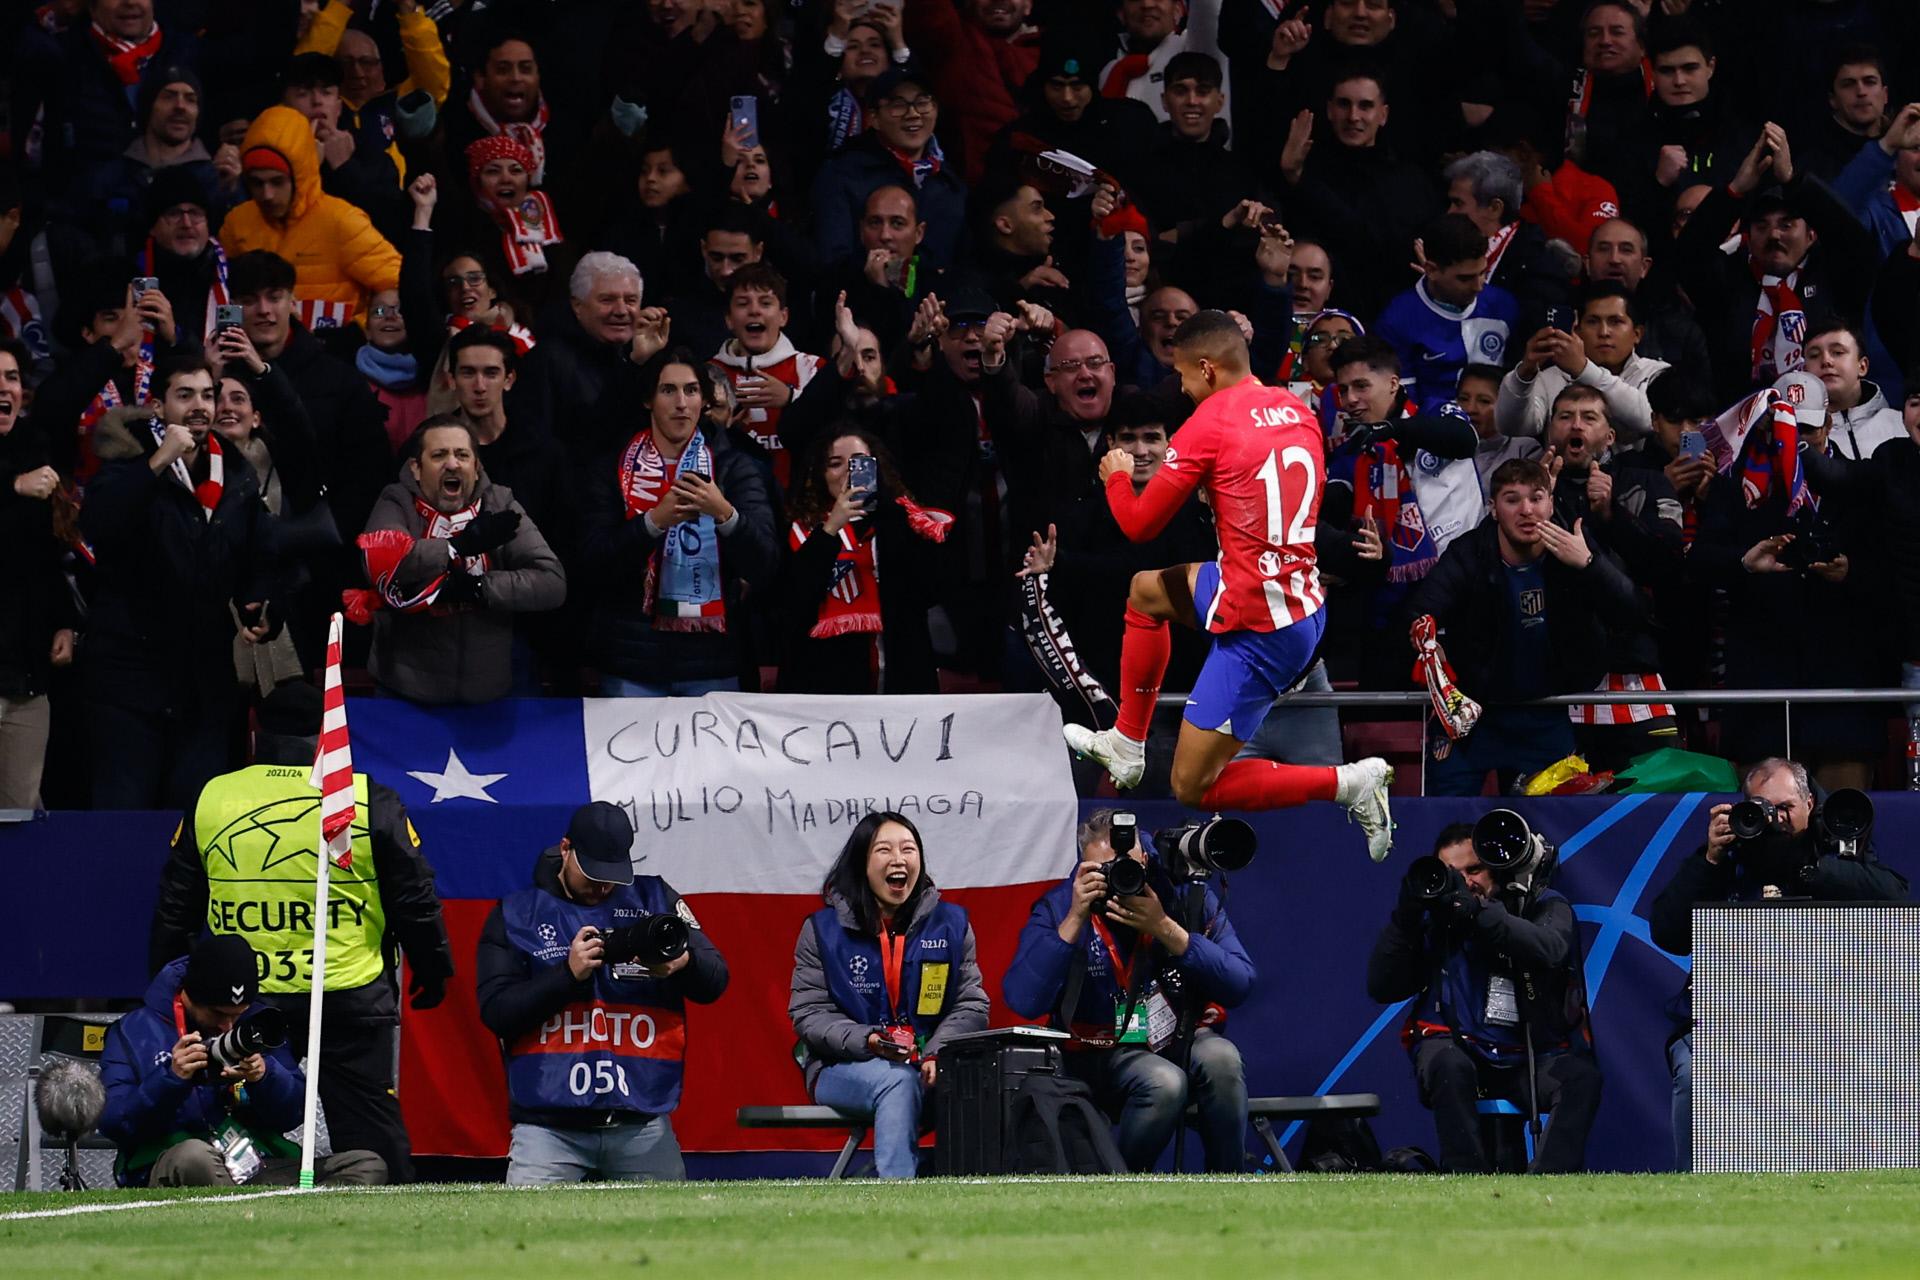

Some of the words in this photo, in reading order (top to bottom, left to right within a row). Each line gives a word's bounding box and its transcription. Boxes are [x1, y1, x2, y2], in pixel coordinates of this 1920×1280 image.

[1250, 406, 1300, 428] S.LINO
[1255, 445, 1317, 547] 12
[1037, 631, 1063, 671] PADRES
[606, 710, 955, 766] CURACAVI
[265, 768, 303, 778] 2021/24
[210, 899, 368, 932] SECURTY
[1523, 972, 1536, 1001] Cann
[539, 1007, 656, 1049] PHOTO
[568, 1060, 630, 1097] 058
